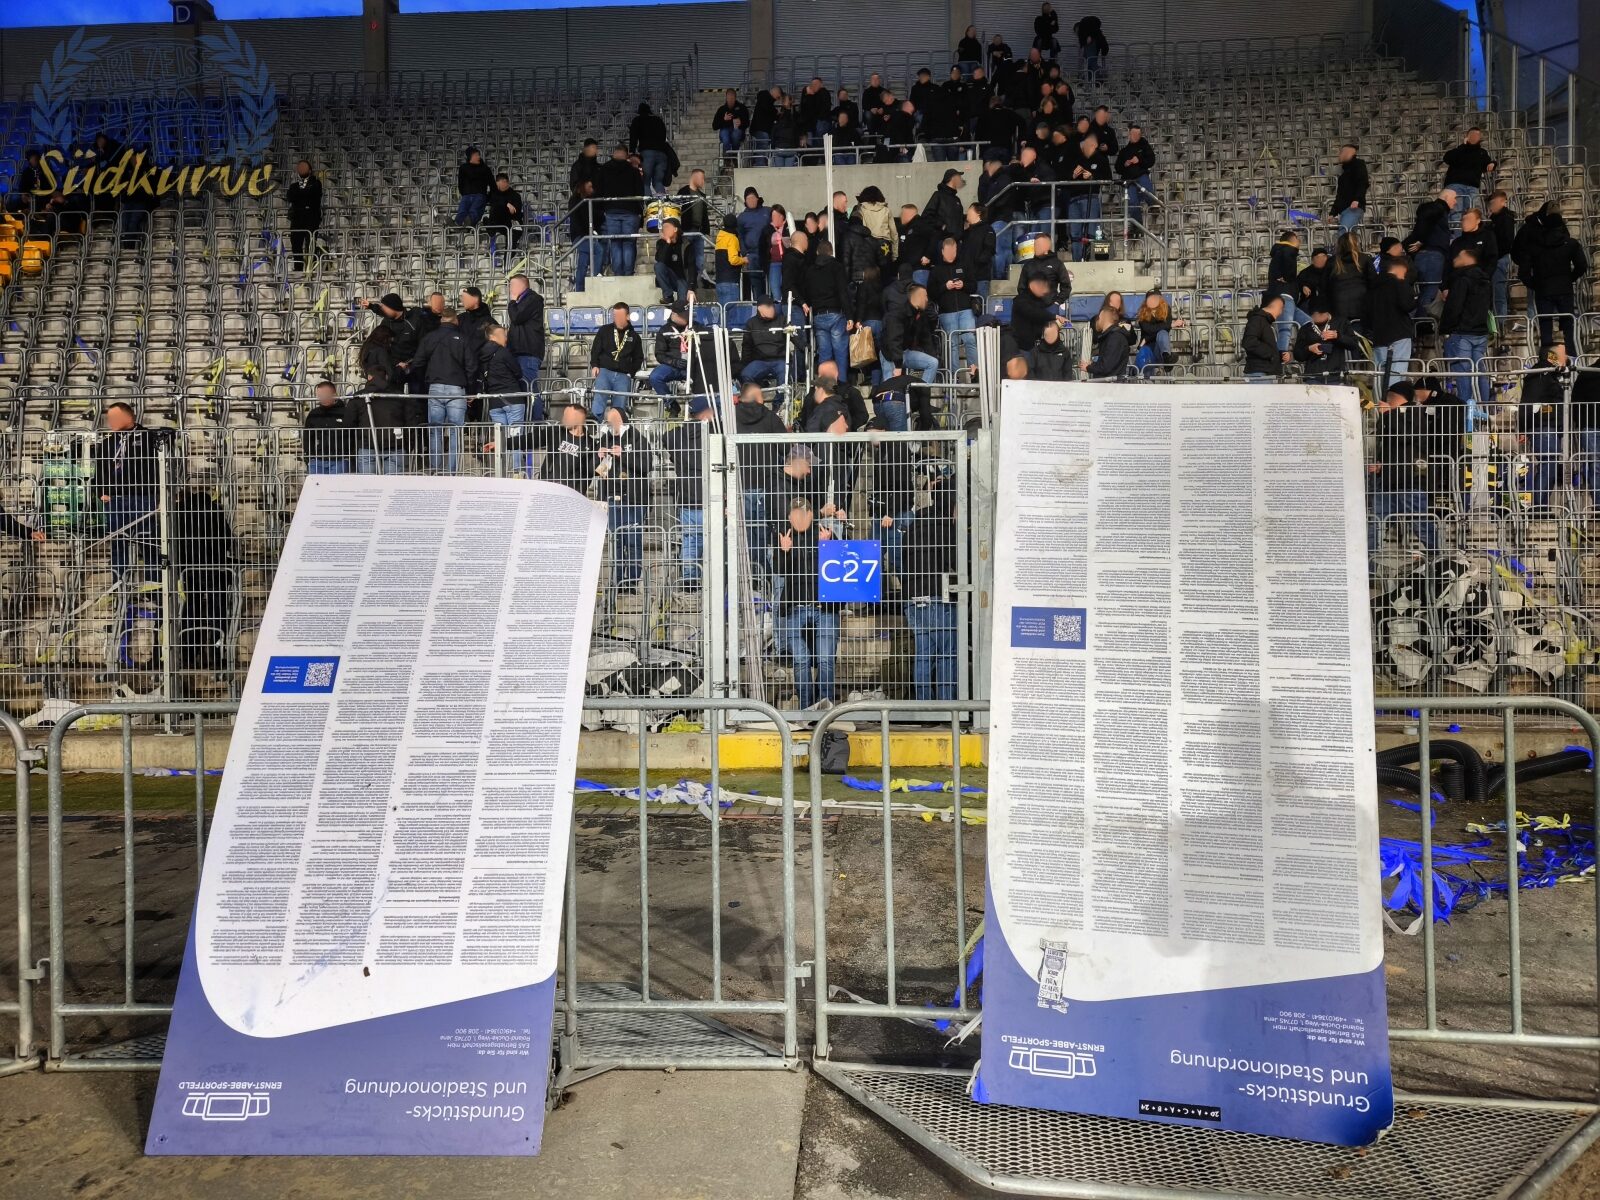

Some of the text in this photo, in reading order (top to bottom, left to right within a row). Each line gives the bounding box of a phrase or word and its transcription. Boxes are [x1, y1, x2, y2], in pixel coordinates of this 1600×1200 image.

[176, 5, 190, 22] D
[822, 560, 878, 583] C27
[1289, 1025, 1350, 1037] Betriebsgesellschaft
[1001, 1034, 1105, 1052] ERNST-ABBE-SPORTFELD
[1170, 1049, 1369, 1086] und Stadionordnung
[178, 1081, 282, 1089] ERNST-ABBE-SPORTFELD
[344, 1079, 527, 1098] und Stadionordnung
[1238, 1083, 1370, 1113] Grundstücks-
[406, 1105, 525, 1122] Grundstücks-
